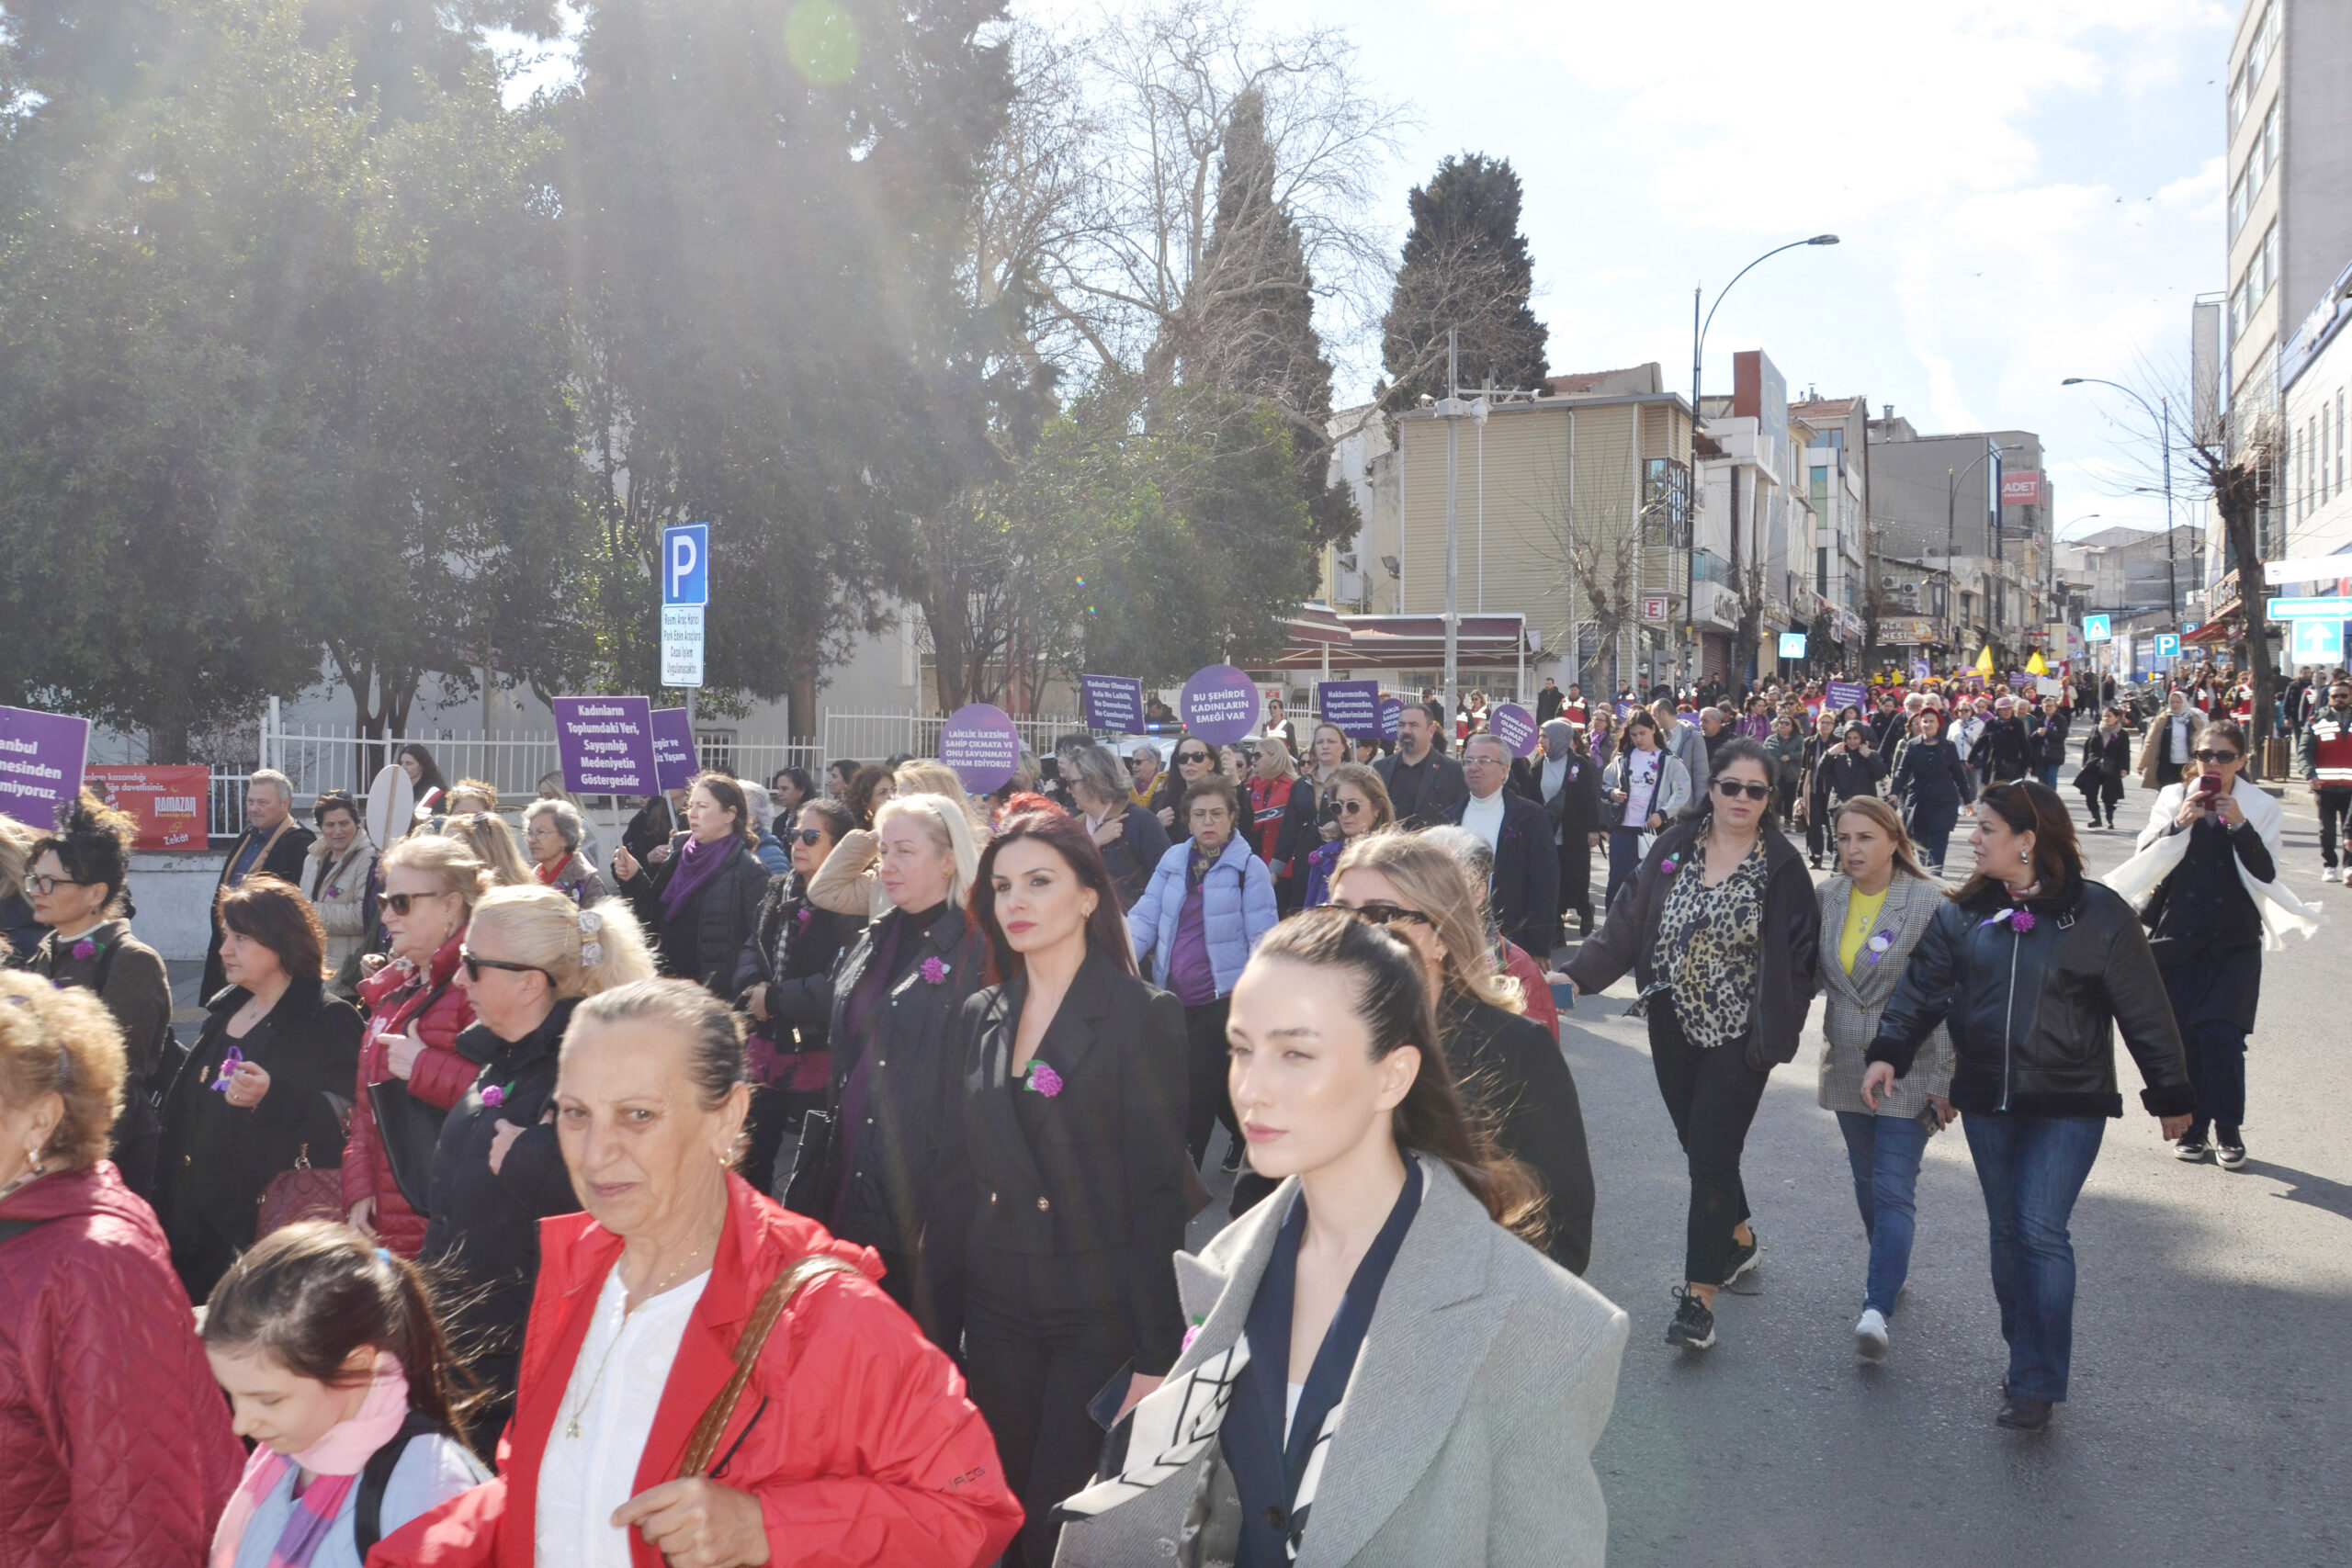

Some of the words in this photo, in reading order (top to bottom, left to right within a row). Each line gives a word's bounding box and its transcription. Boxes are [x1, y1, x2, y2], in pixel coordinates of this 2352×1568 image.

[673, 535, 697, 598] P
[1648, 602, 1659, 617] E
[2159, 637, 2176, 655] P
[1193, 693, 1206, 702] BU
[1207, 689, 1246, 703] ŞEHİRDE
[578, 704, 625, 716] Kadınların
[1191, 700, 1250, 713] KADINLARIN
[1196, 712, 1225, 723] EMEĞİ
[1226, 712, 1246, 720] VAR
[567, 722, 619, 736] Toplumdaki
[619, 722, 640, 736] Yeri,
[1332, 721, 1374, 730] zgeçmiyoruz
[948, 729, 977, 739] LAİKLİK
[978, 729, 1011, 739] İLKESİNE
[583, 739, 628, 754] Saygınlığı
[944, 739, 967, 748] SAHİP
[968, 740, 1002, 750] ÇIKMAYA
[664, 752, 687, 763] Yaşam
[964, 750, 1012, 759] SAVUNMAYA
[581, 756, 636, 772] Medeniyetin
[946, 759, 973, 767] DEVAM
[974, 759, 1012, 768] EDİYORUZ
[581, 773, 640, 788] Göstergesidir
[154, 796, 197, 818] RAMAZAN
